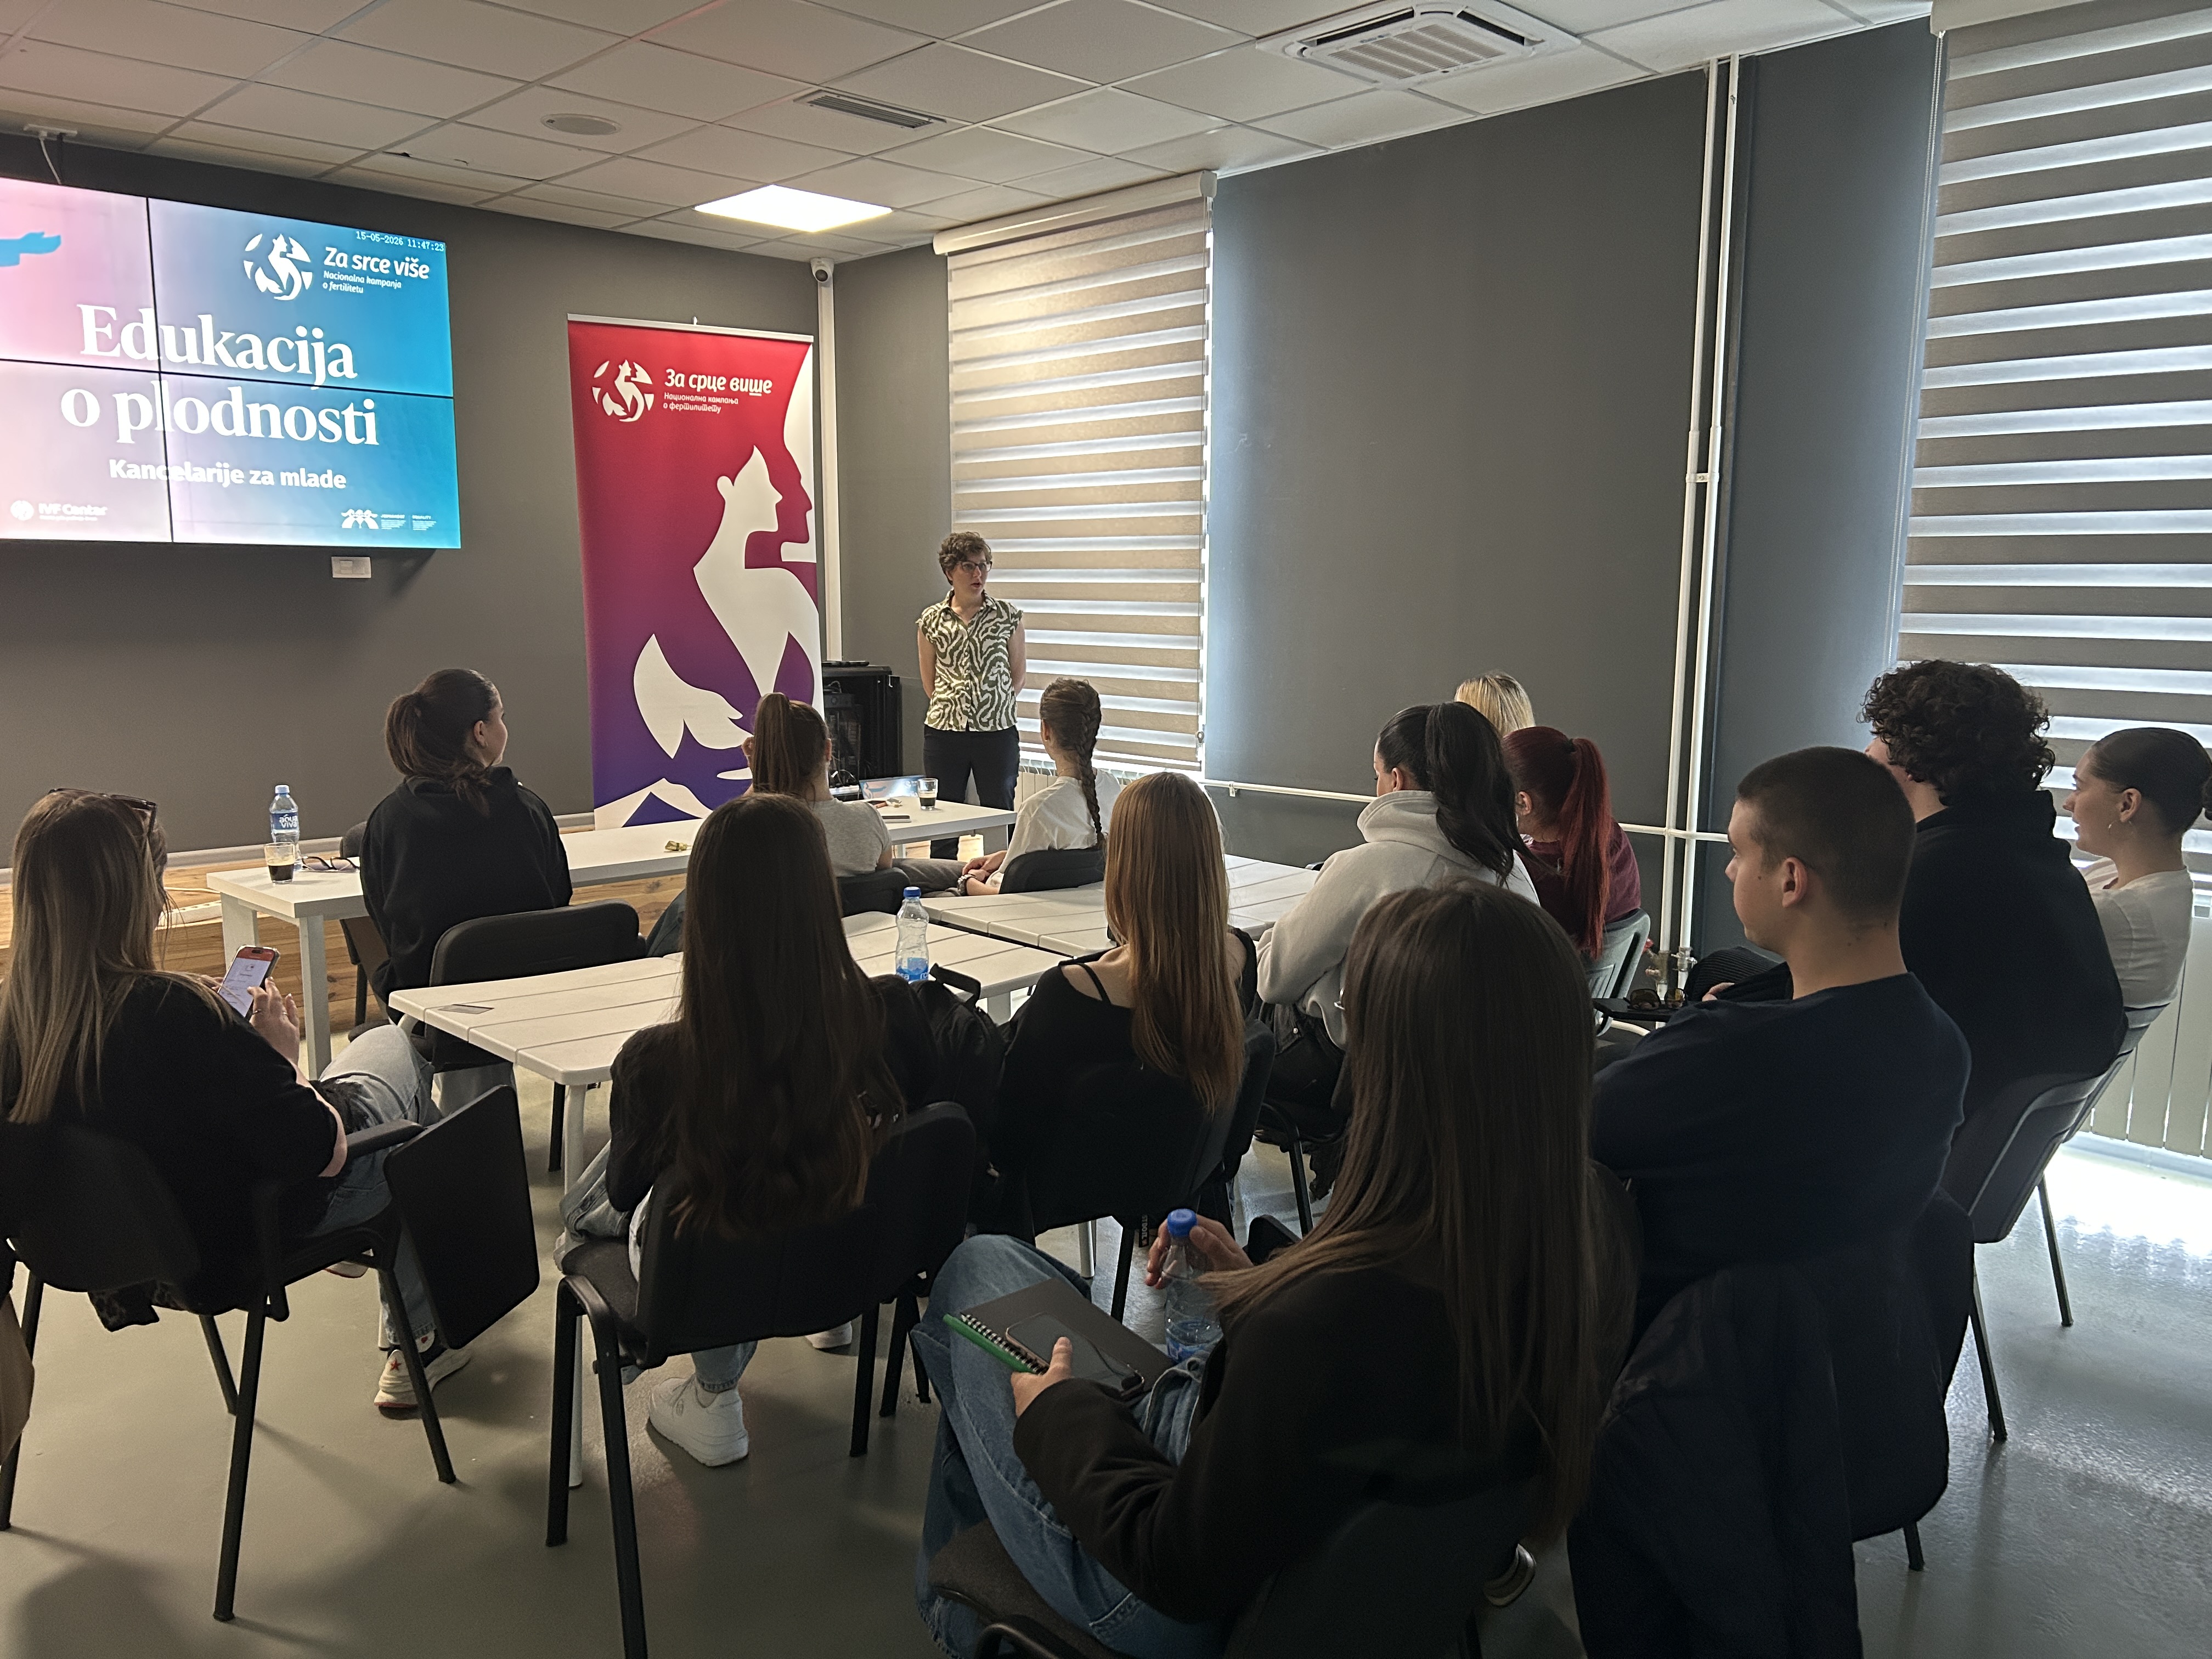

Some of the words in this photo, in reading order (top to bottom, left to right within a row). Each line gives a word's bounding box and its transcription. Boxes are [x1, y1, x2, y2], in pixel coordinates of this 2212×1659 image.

[357, 231, 403, 245] 15-05-2026
[408, 239, 444, 252] 11:47:23
[324, 247, 348, 268] Za
[351, 254, 391, 274] srce
[394, 257, 430, 279] više
[324, 270, 365, 284] Nacionalna
[366, 276, 402, 289] kampanja
[329, 281, 364, 294] fertilitetu
[76, 304, 358, 390] Edukacija
[664, 368, 685, 387] За
[689, 374, 727, 392] срце
[729, 377, 773, 396] више
[664, 392, 707, 402] Национална
[708, 395, 738, 404] кампања
[61, 388, 100, 427] o
[112, 380, 379, 445] plodnosti
[109, 459, 245, 488] Kancelarije
[249, 469, 275, 486] za
[280, 467, 347, 489] mlade
